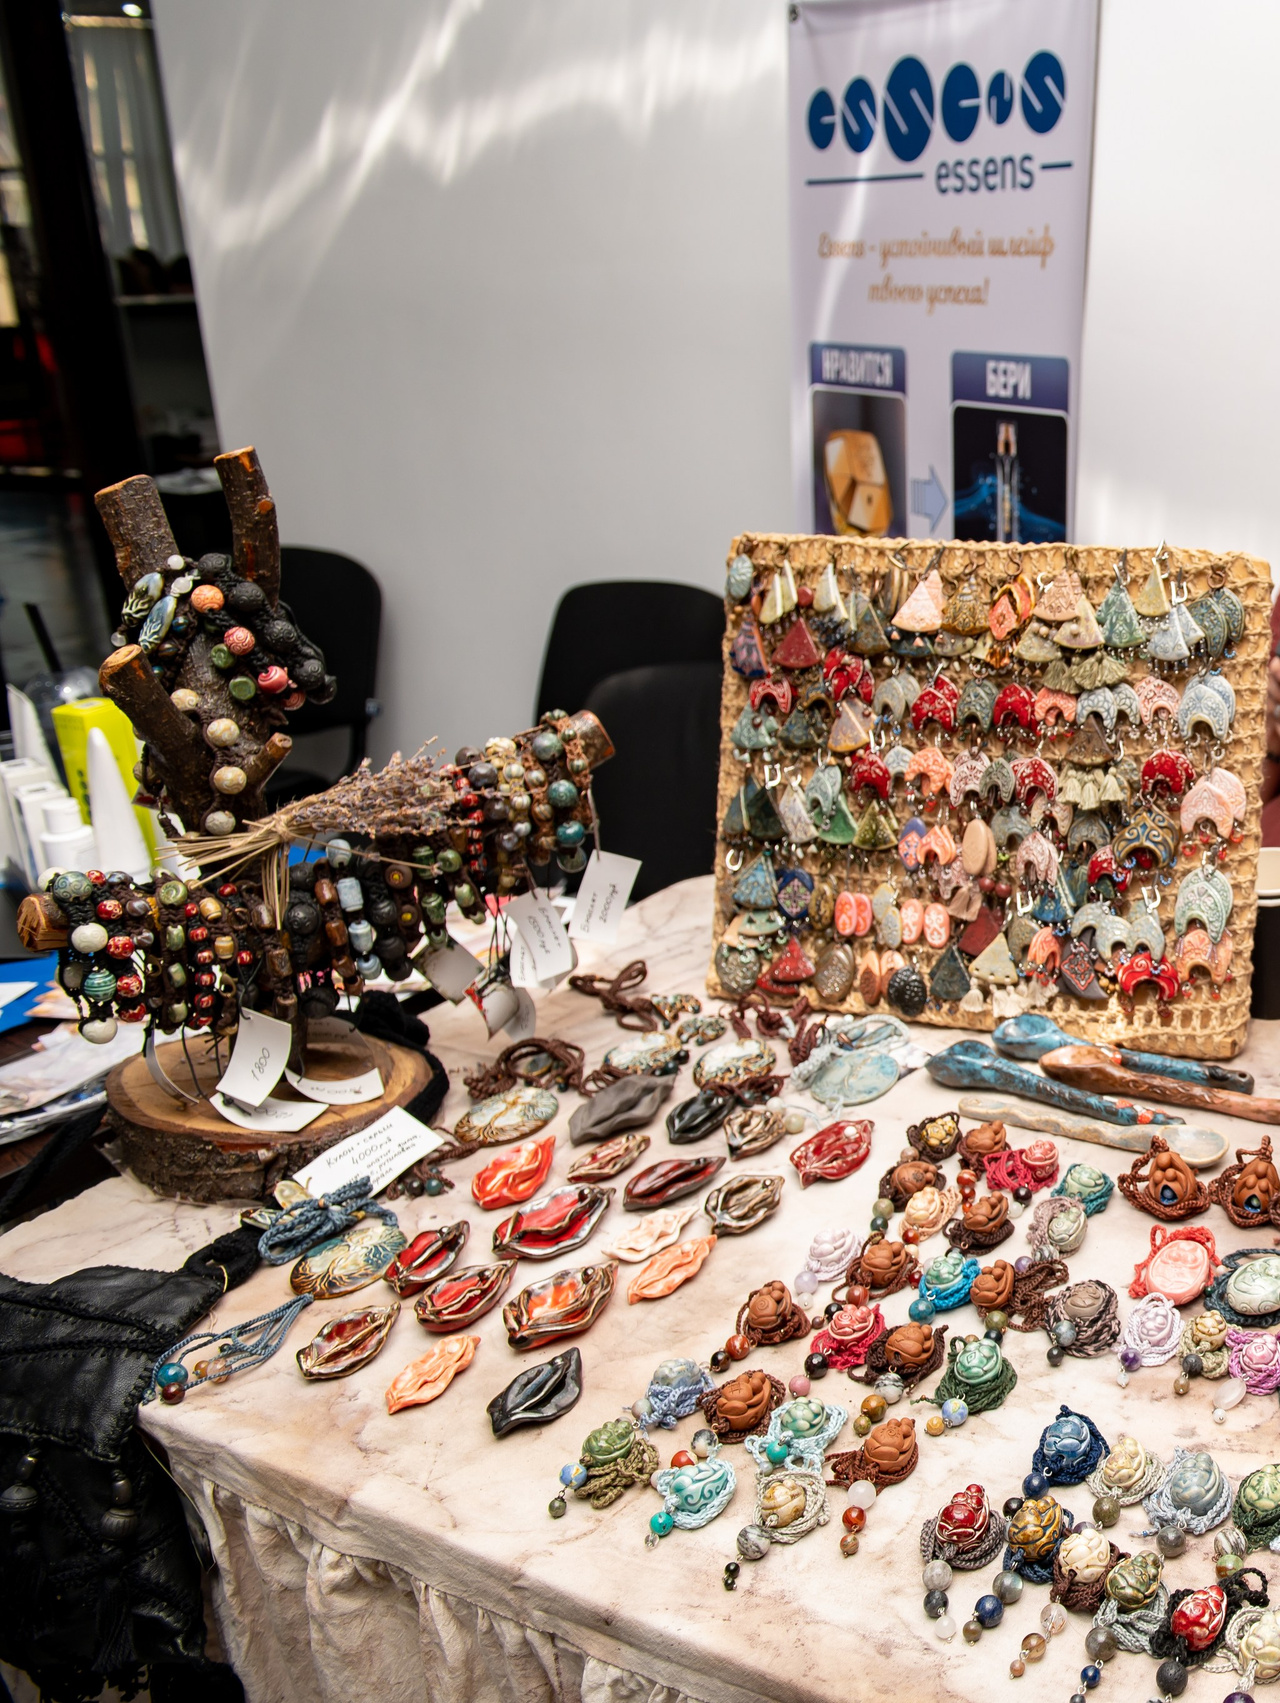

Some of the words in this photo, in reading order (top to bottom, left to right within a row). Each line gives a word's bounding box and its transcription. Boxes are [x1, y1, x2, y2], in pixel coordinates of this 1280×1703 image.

[935, 152, 1035, 194] essens
[879, 226, 985, 270] устойчивый
[988, 223, 1056, 269] шлейф
[867, 273, 924, 304] твоего
[926, 277, 990, 316] успеха!
[821, 348, 894, 388] НРАВИТСЯ
[985, 359, 1032, 400] БЕРИ
[251, 1047, 270, 1082] 1800
